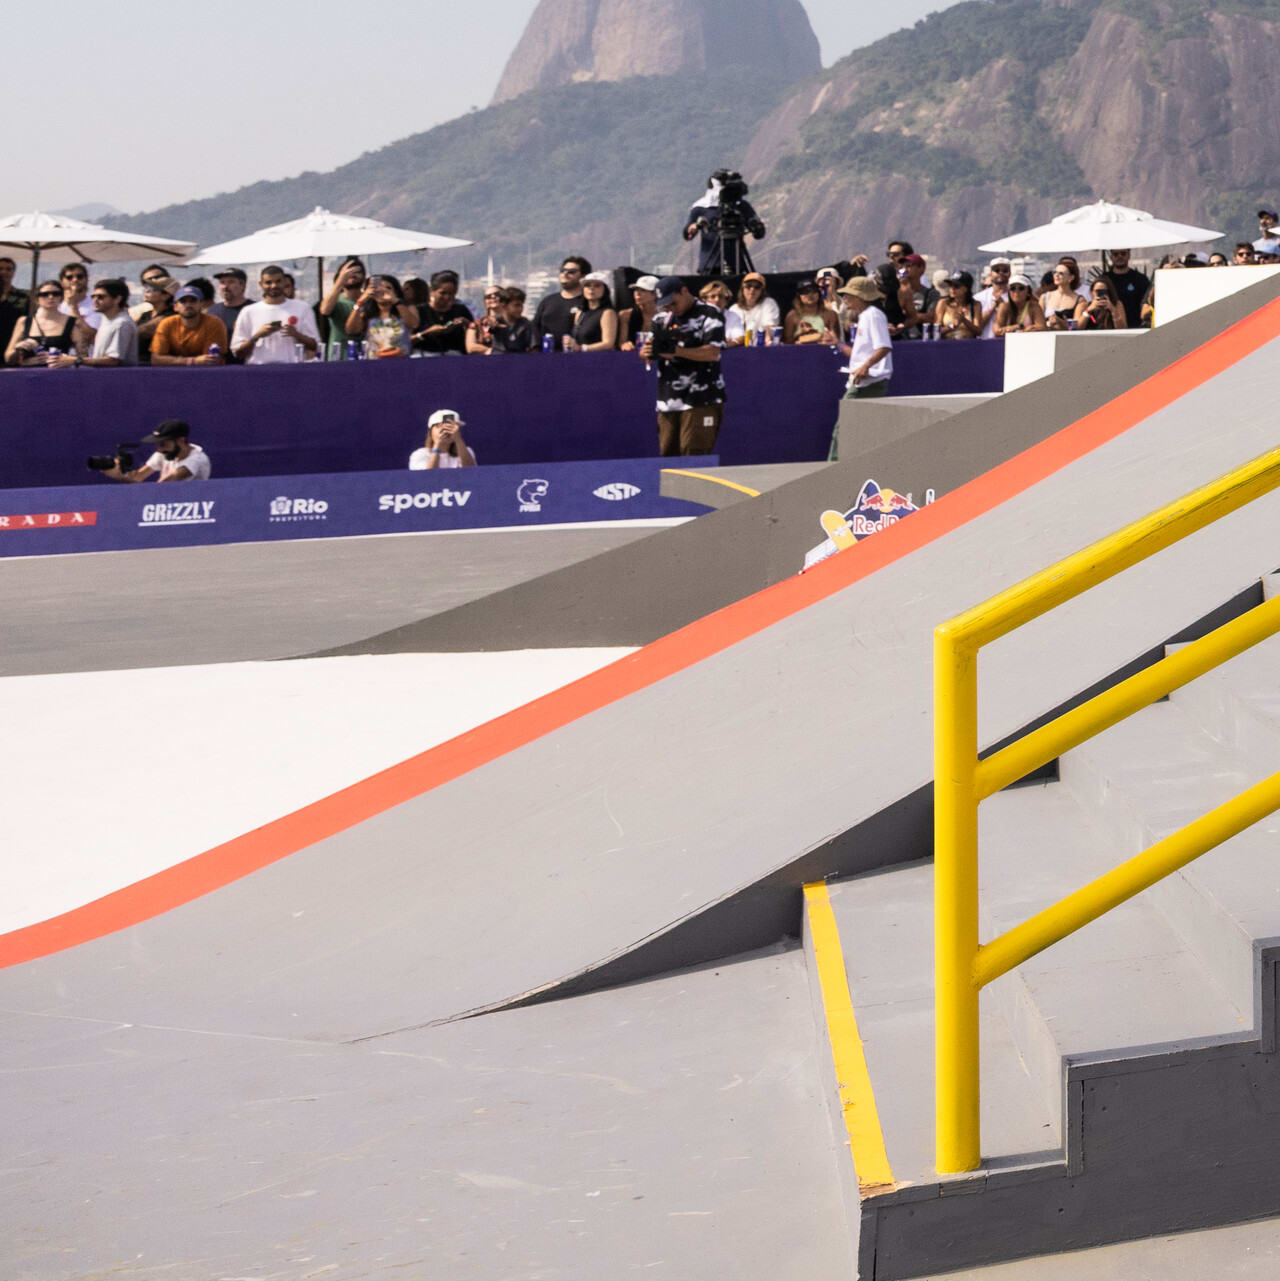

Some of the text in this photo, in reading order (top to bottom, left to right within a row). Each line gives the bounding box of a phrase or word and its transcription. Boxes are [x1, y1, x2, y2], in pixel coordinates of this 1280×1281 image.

[292, 498, 329, 515] Rio
[378, 488, 472, 514] sportv
[854, 514, 885, 533] Red
